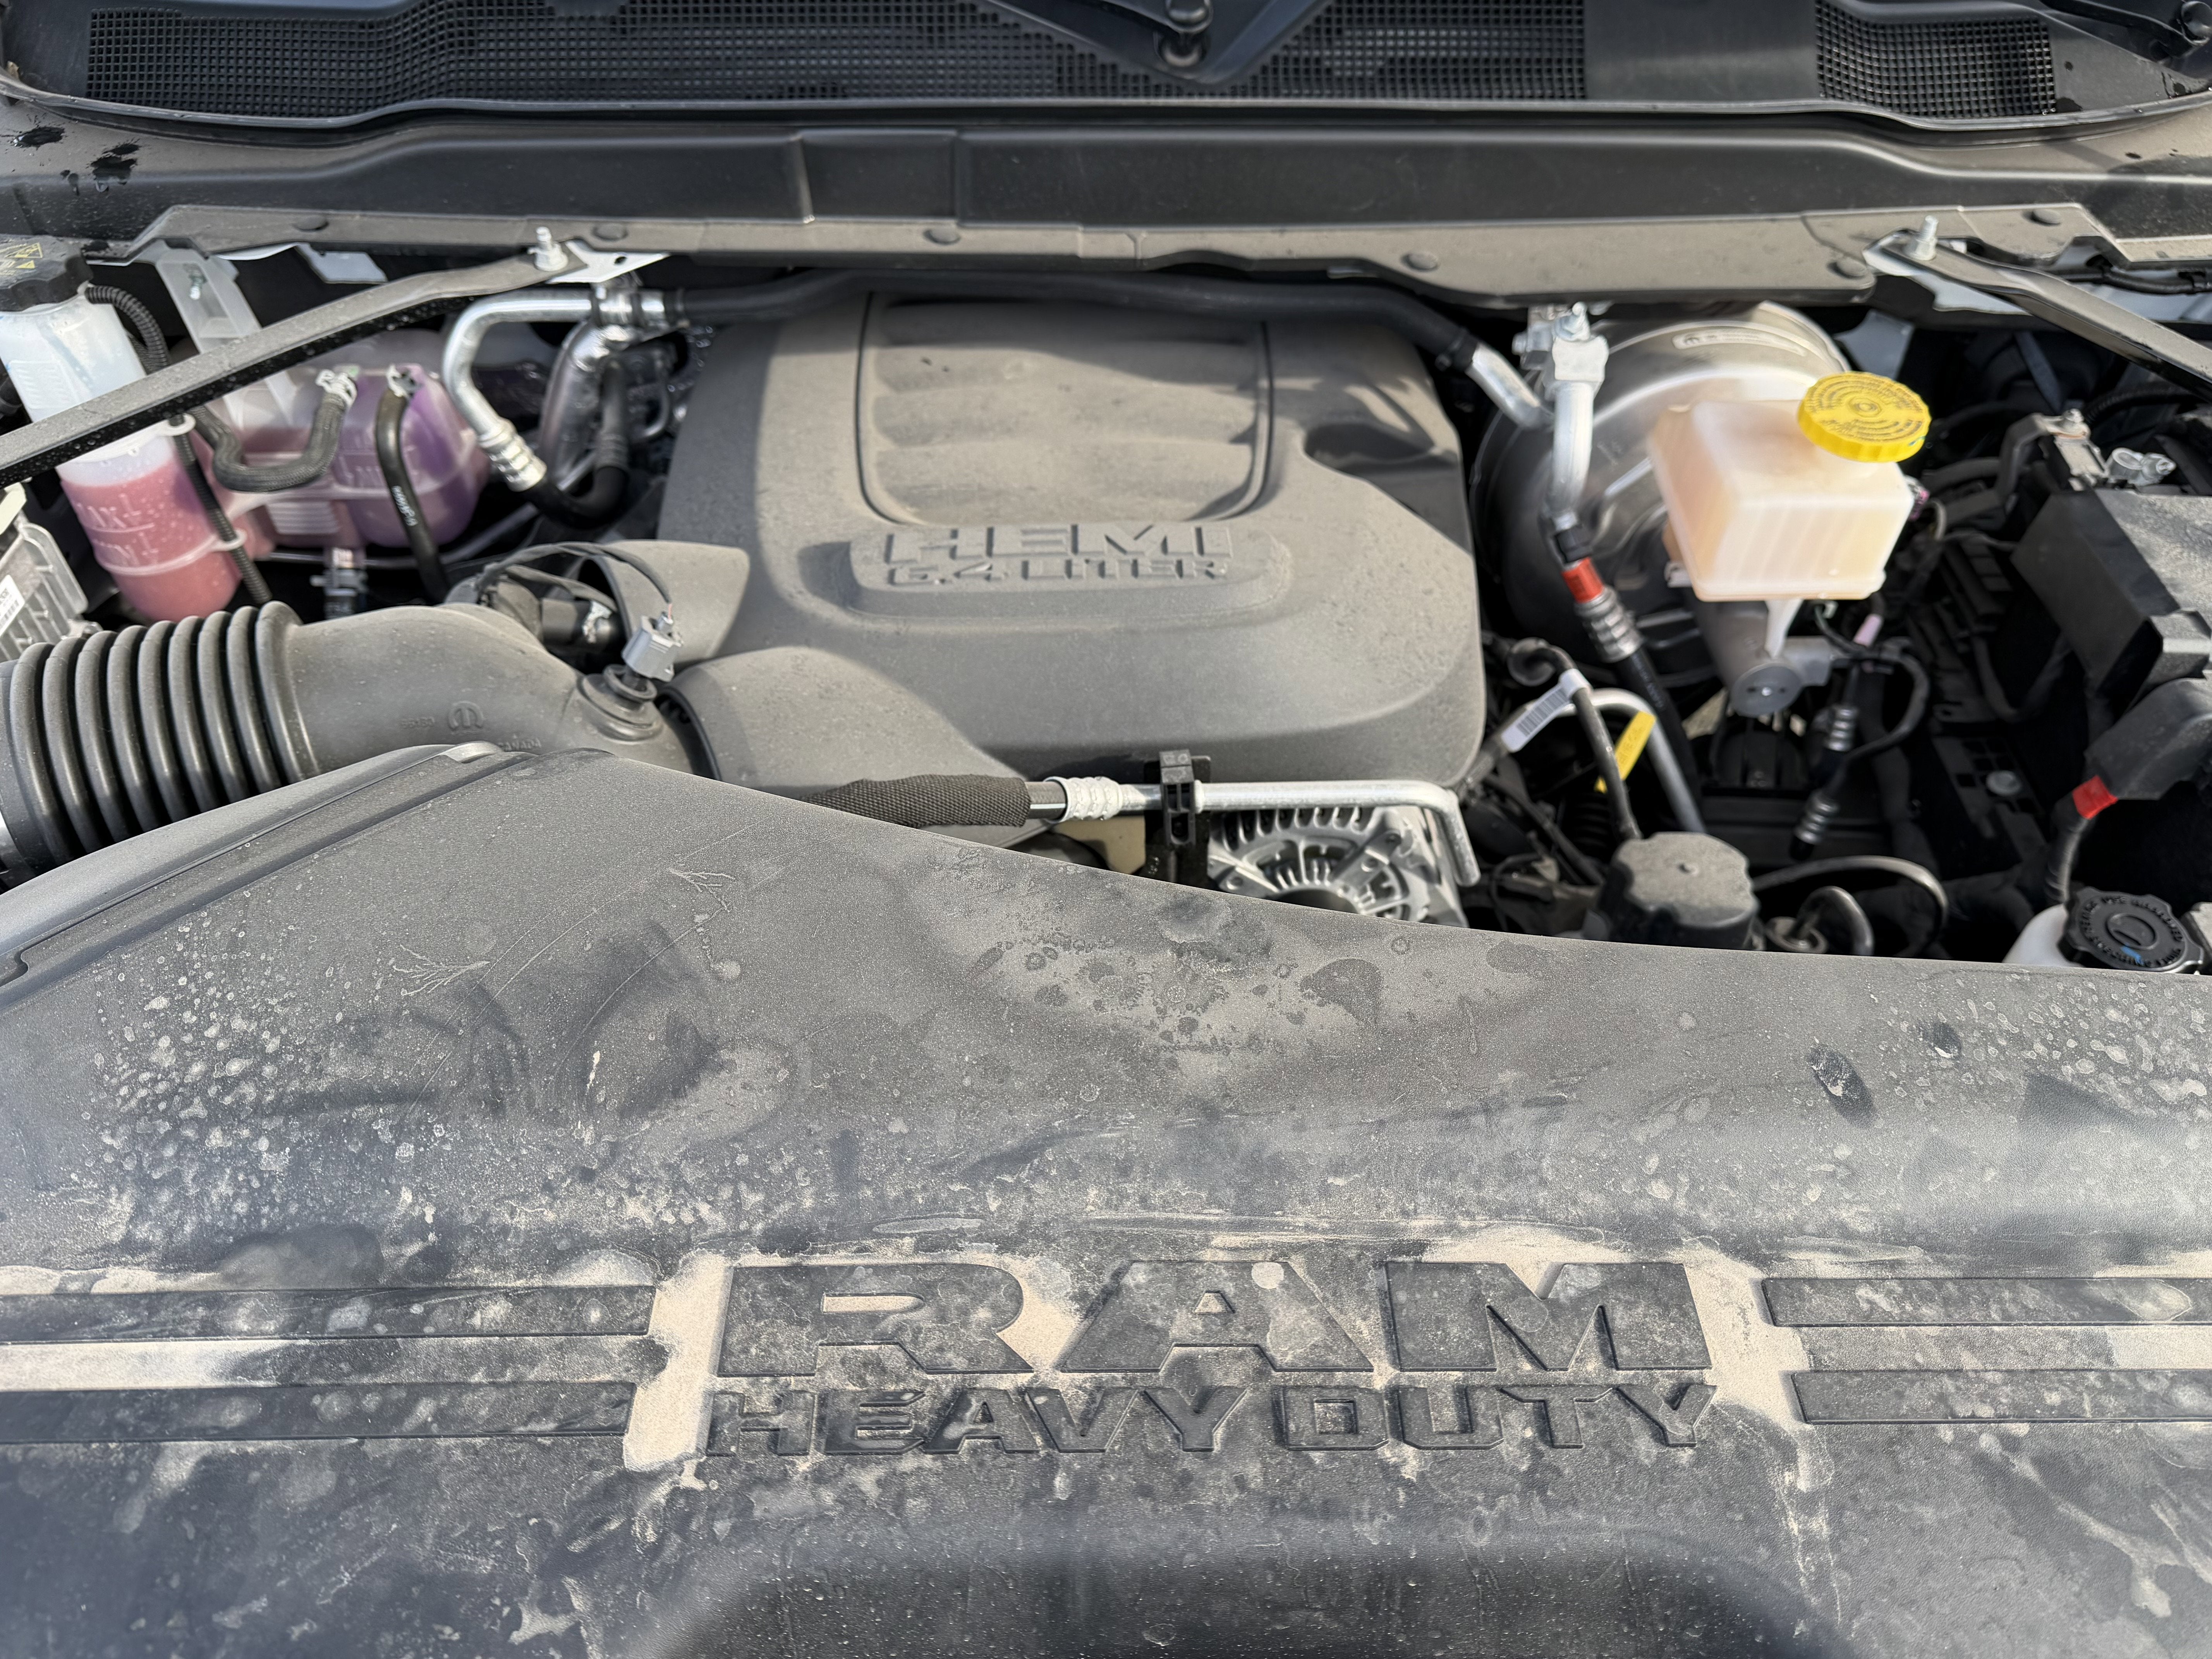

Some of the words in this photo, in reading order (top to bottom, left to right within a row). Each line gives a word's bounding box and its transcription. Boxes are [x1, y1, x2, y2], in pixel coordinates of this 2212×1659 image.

[883, 524, 1233, 564] HEMI
[716, 1259, 1712, 1377] RAM
[706, 1385, 1247, 1457] HEAVY
[1277, 1383, 1717, 1451] DUTY
